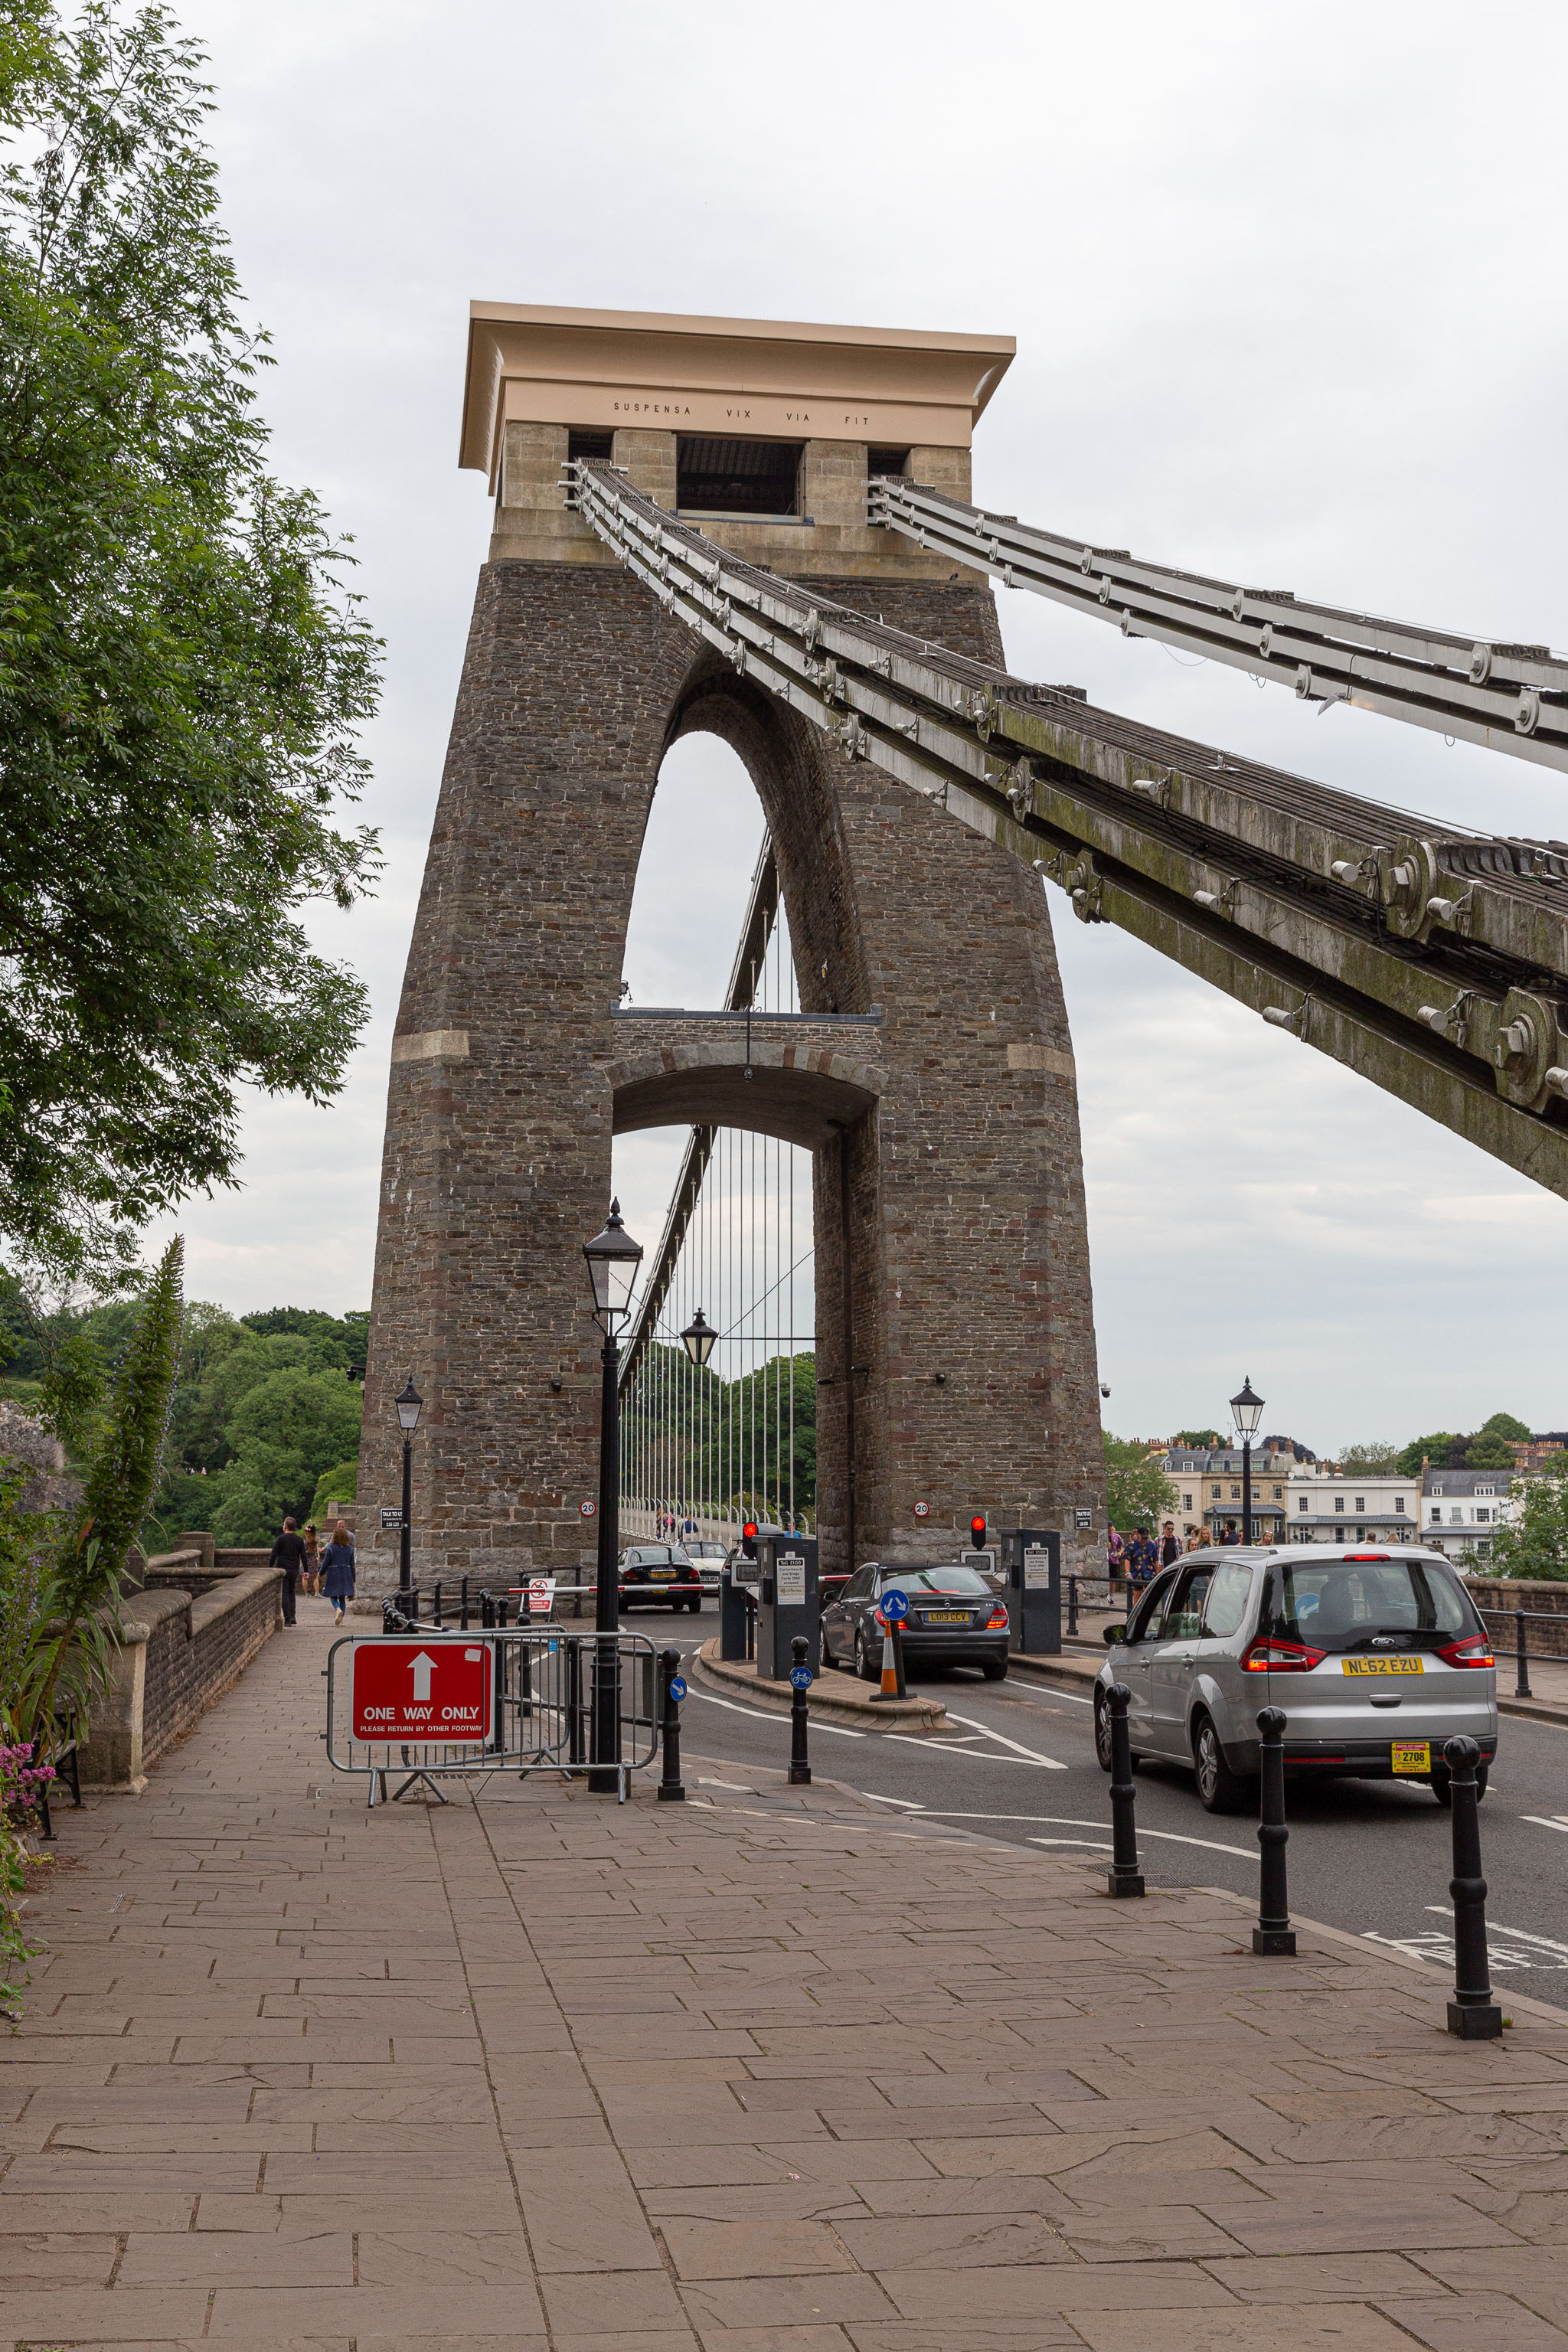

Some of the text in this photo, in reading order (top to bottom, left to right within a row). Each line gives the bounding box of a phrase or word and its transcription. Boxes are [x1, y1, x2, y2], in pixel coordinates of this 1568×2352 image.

[614, 402, 868, 425] SUSPENSA VIX VIA FIT
[931, 1612, 965, 1621] LO13 CCV
[1348, 1659, 1419, 1674] NL62 EZU
[364, 1707, 480, 1720] ONE WAY ONLY
[1403, 1752, 1425, 1762] 2708
